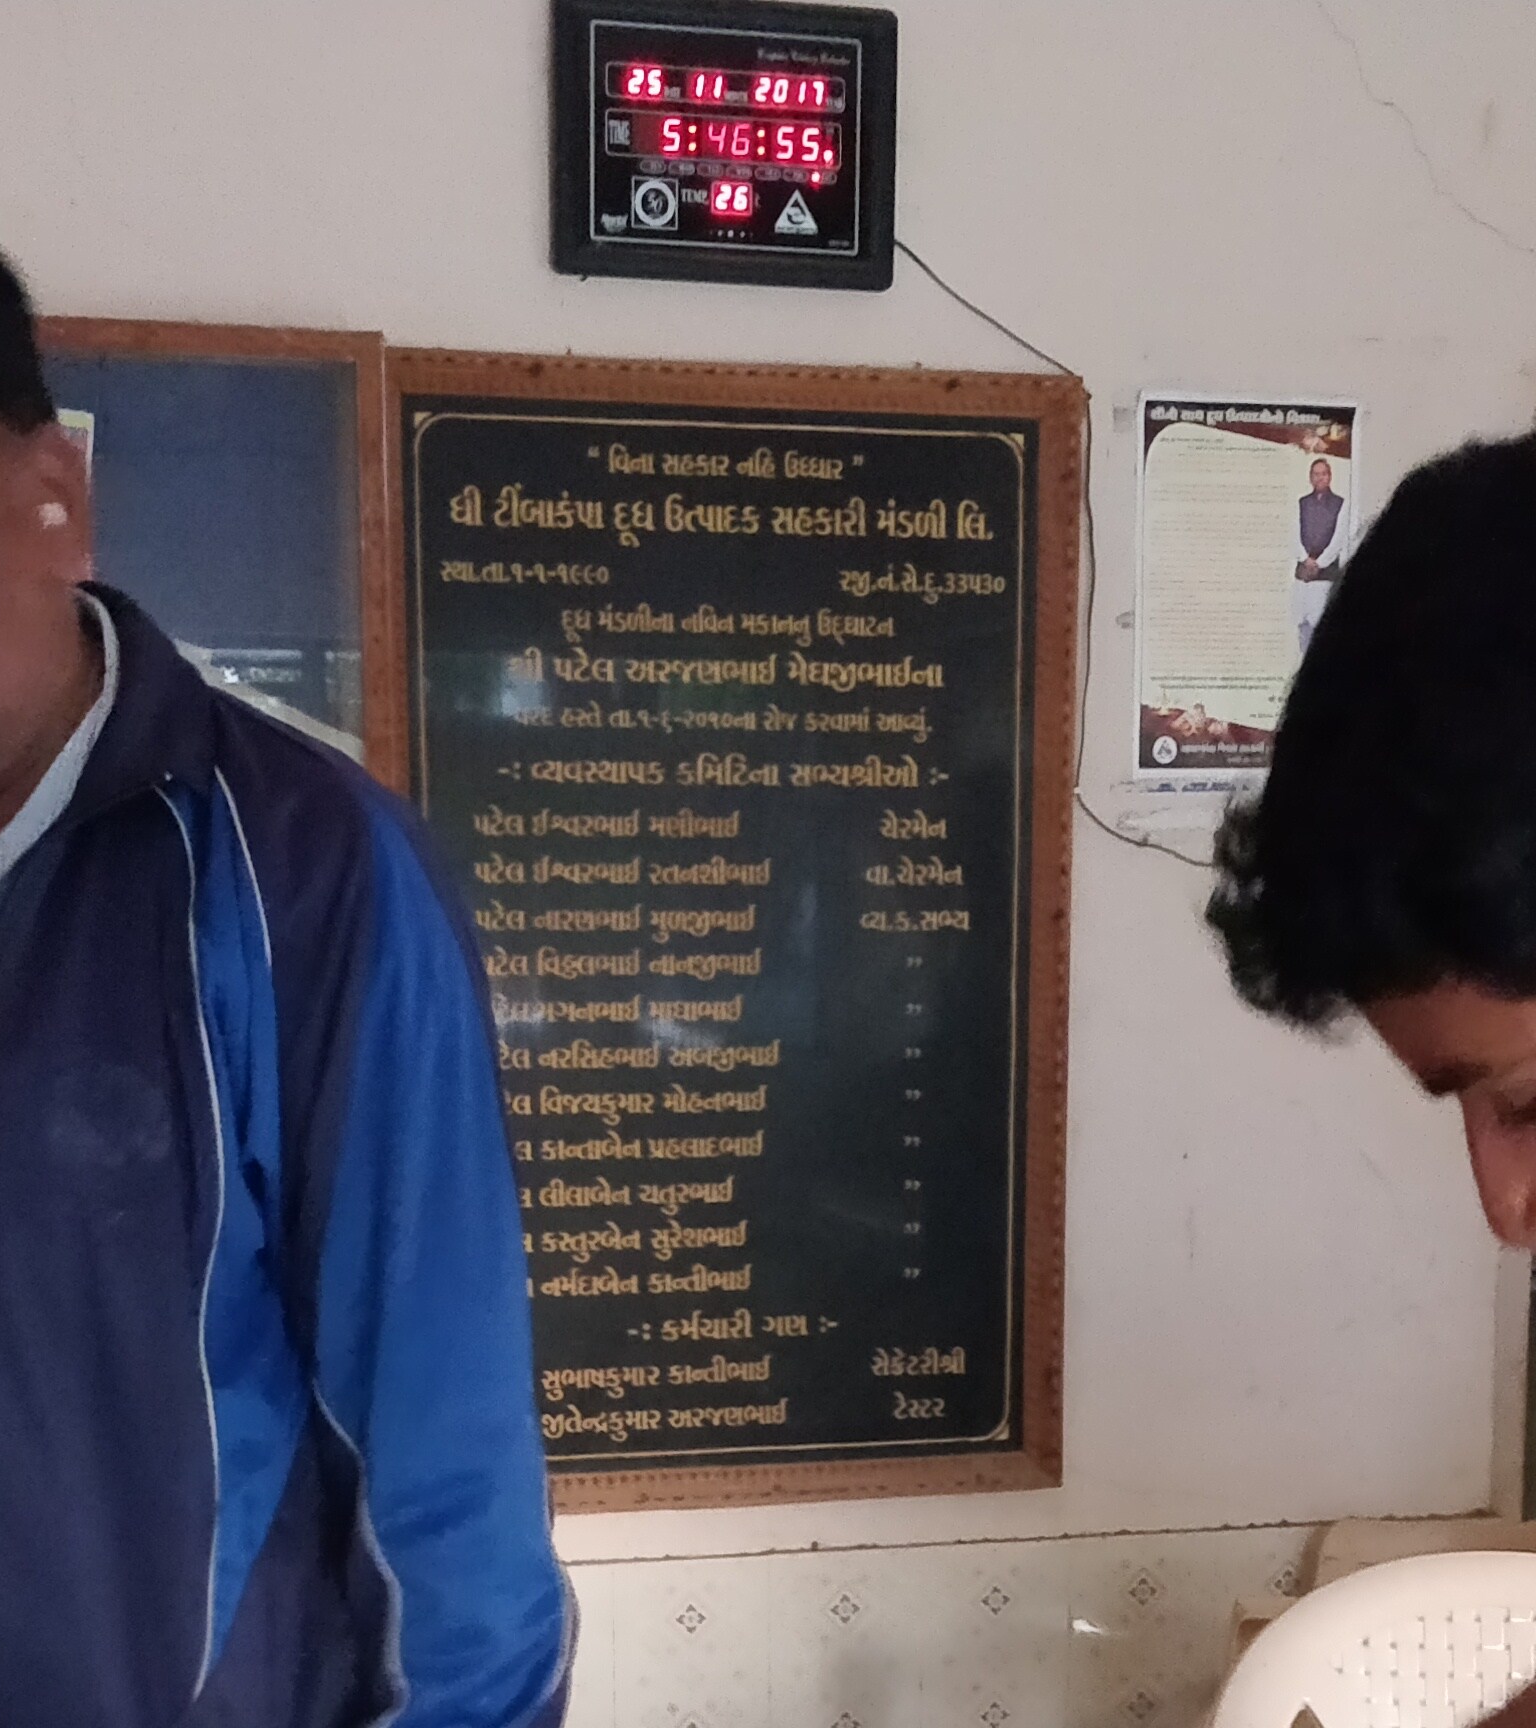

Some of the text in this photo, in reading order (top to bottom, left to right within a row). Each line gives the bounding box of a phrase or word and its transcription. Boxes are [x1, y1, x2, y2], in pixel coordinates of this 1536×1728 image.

[628, 68, 662, 96] 25
[695, 73, 723, 99] 11
[754, 76, 825, 106] 2017
[714, 184, 749, 211] 26
[609, 443, 655, 475] વિના
[662, 453, 730, 477] સહકાર
[735, 447, 776, 479] નહિ
[494, 481, 605, 530] ટીંબાકંપા
[613, 500, 656, 548] દૂધ
[665, 492, 761, 535] ઉત્પાદક
[771, 496, 867, 537] સહકારી
[875, 498, 947, 538] મંડળી
[956, 499, 995, 541] લિ.
[560, 607, 592, 645] દૂધ
[598, 601, 676, 634] મંડળીના
[681, 603, 734, 636] નવિન
[553, 646, 616, 683] પટેલ
[625, 653, 778, 685] અરજણભાઈ
[787, 650, 945, 693] મેઘજીભાઈના
[560, 699, 604, 729] હસ્તે
[762, 703, 799, 732] રોજ
[804, 705, 871, 733] કરવામાં
[875, 705, 934, 744] આવ્યું.
[530, 759, 666, 785] વ્યવસ્થાપક
[676, 753, 781, 787] કમિટિના
[789, 752, 920, 788] સભ્યશ્રીઓ
[474, 803, 524, 838] પટેલ
[531, 807, 641, 838] ઈશ્વરભાઈ
[879, 807, 948, 840] ચેરમેન
[474, 852, 525, 885] પટેલ
[532, 853, 642, 885] ઈશ્વરભાઈ
[865, 854, 965, 887] વા.ચેરમેન
[474, 898, 526, 931] પટેલ
[534, 902, 642, 932] નારણભાઈ
[499, 1038, 532, 1070] ટેલ
[540, 1084, 656, 1127] વિજયકુમાર
[663, 1082, 769, 1113] મોહનભાઈ
[541, 1129, 643, 1161] કાન્તાબેન
[646, 1129, 765, 1160] પ્રહલાદભાઈ
[538, 1176, 632, 1208] લીલાબેન
[637, 1174, 736, 1217] ચતુરભાઈ
[650, 1218, 750, 1262] સુરેશભાઈ
[540, 1265, 639, 1298] નર્મદાબેન
[647, 1262, 753, 1295] કાન્તીભાઈ
[661, 1307, 754, 1341] કર્મચારી
[760, 1314, 809, 1337] ગણ
[667, 1353, 773, 1386] કાન્તીભાઈ
[667, 1396, 789, 1429] અરજણભાઈ
[892, 1390, 947, 1421] ટેસ્ટર
